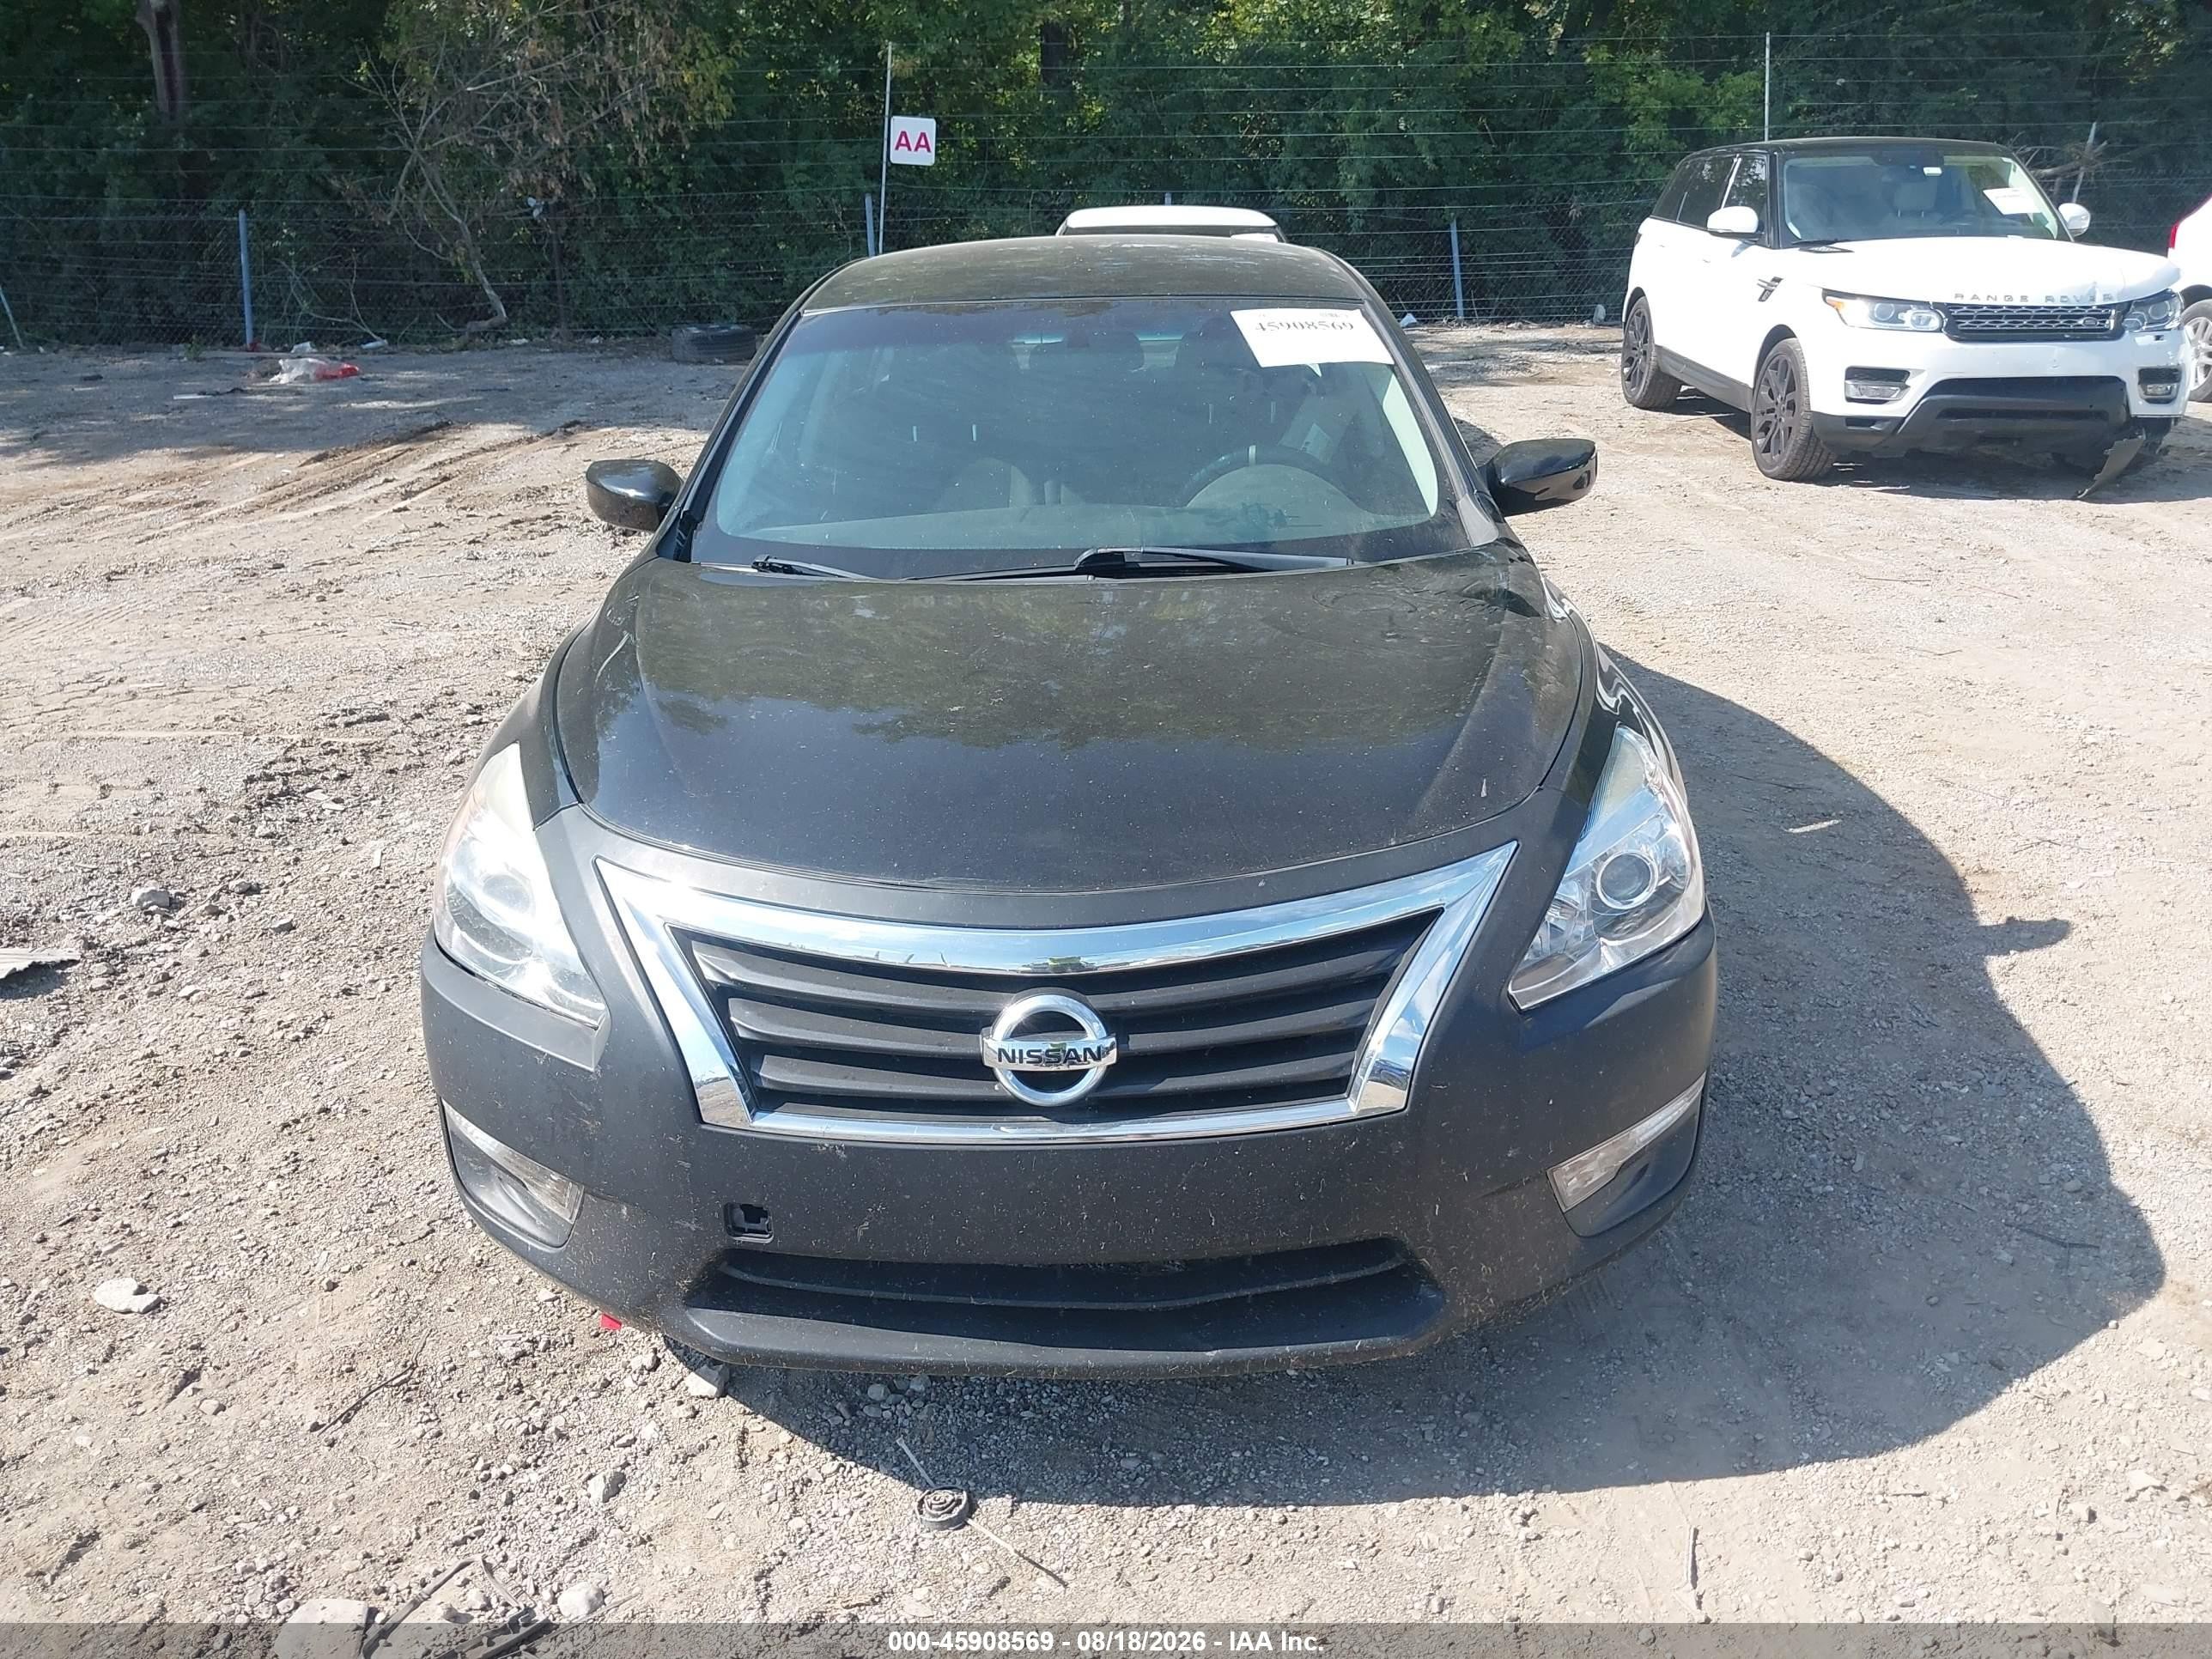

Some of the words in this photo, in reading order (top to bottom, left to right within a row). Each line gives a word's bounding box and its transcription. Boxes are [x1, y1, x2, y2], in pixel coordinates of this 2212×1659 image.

[894, 131, 932, 153] AA
[1954, 293, 2030, 303] RANGE
[2045, 293, 2114, 303] ROVER
[1255, 320, 1354, 332] 45908569
[997, 1043, 1103, 1065] NISSAN
